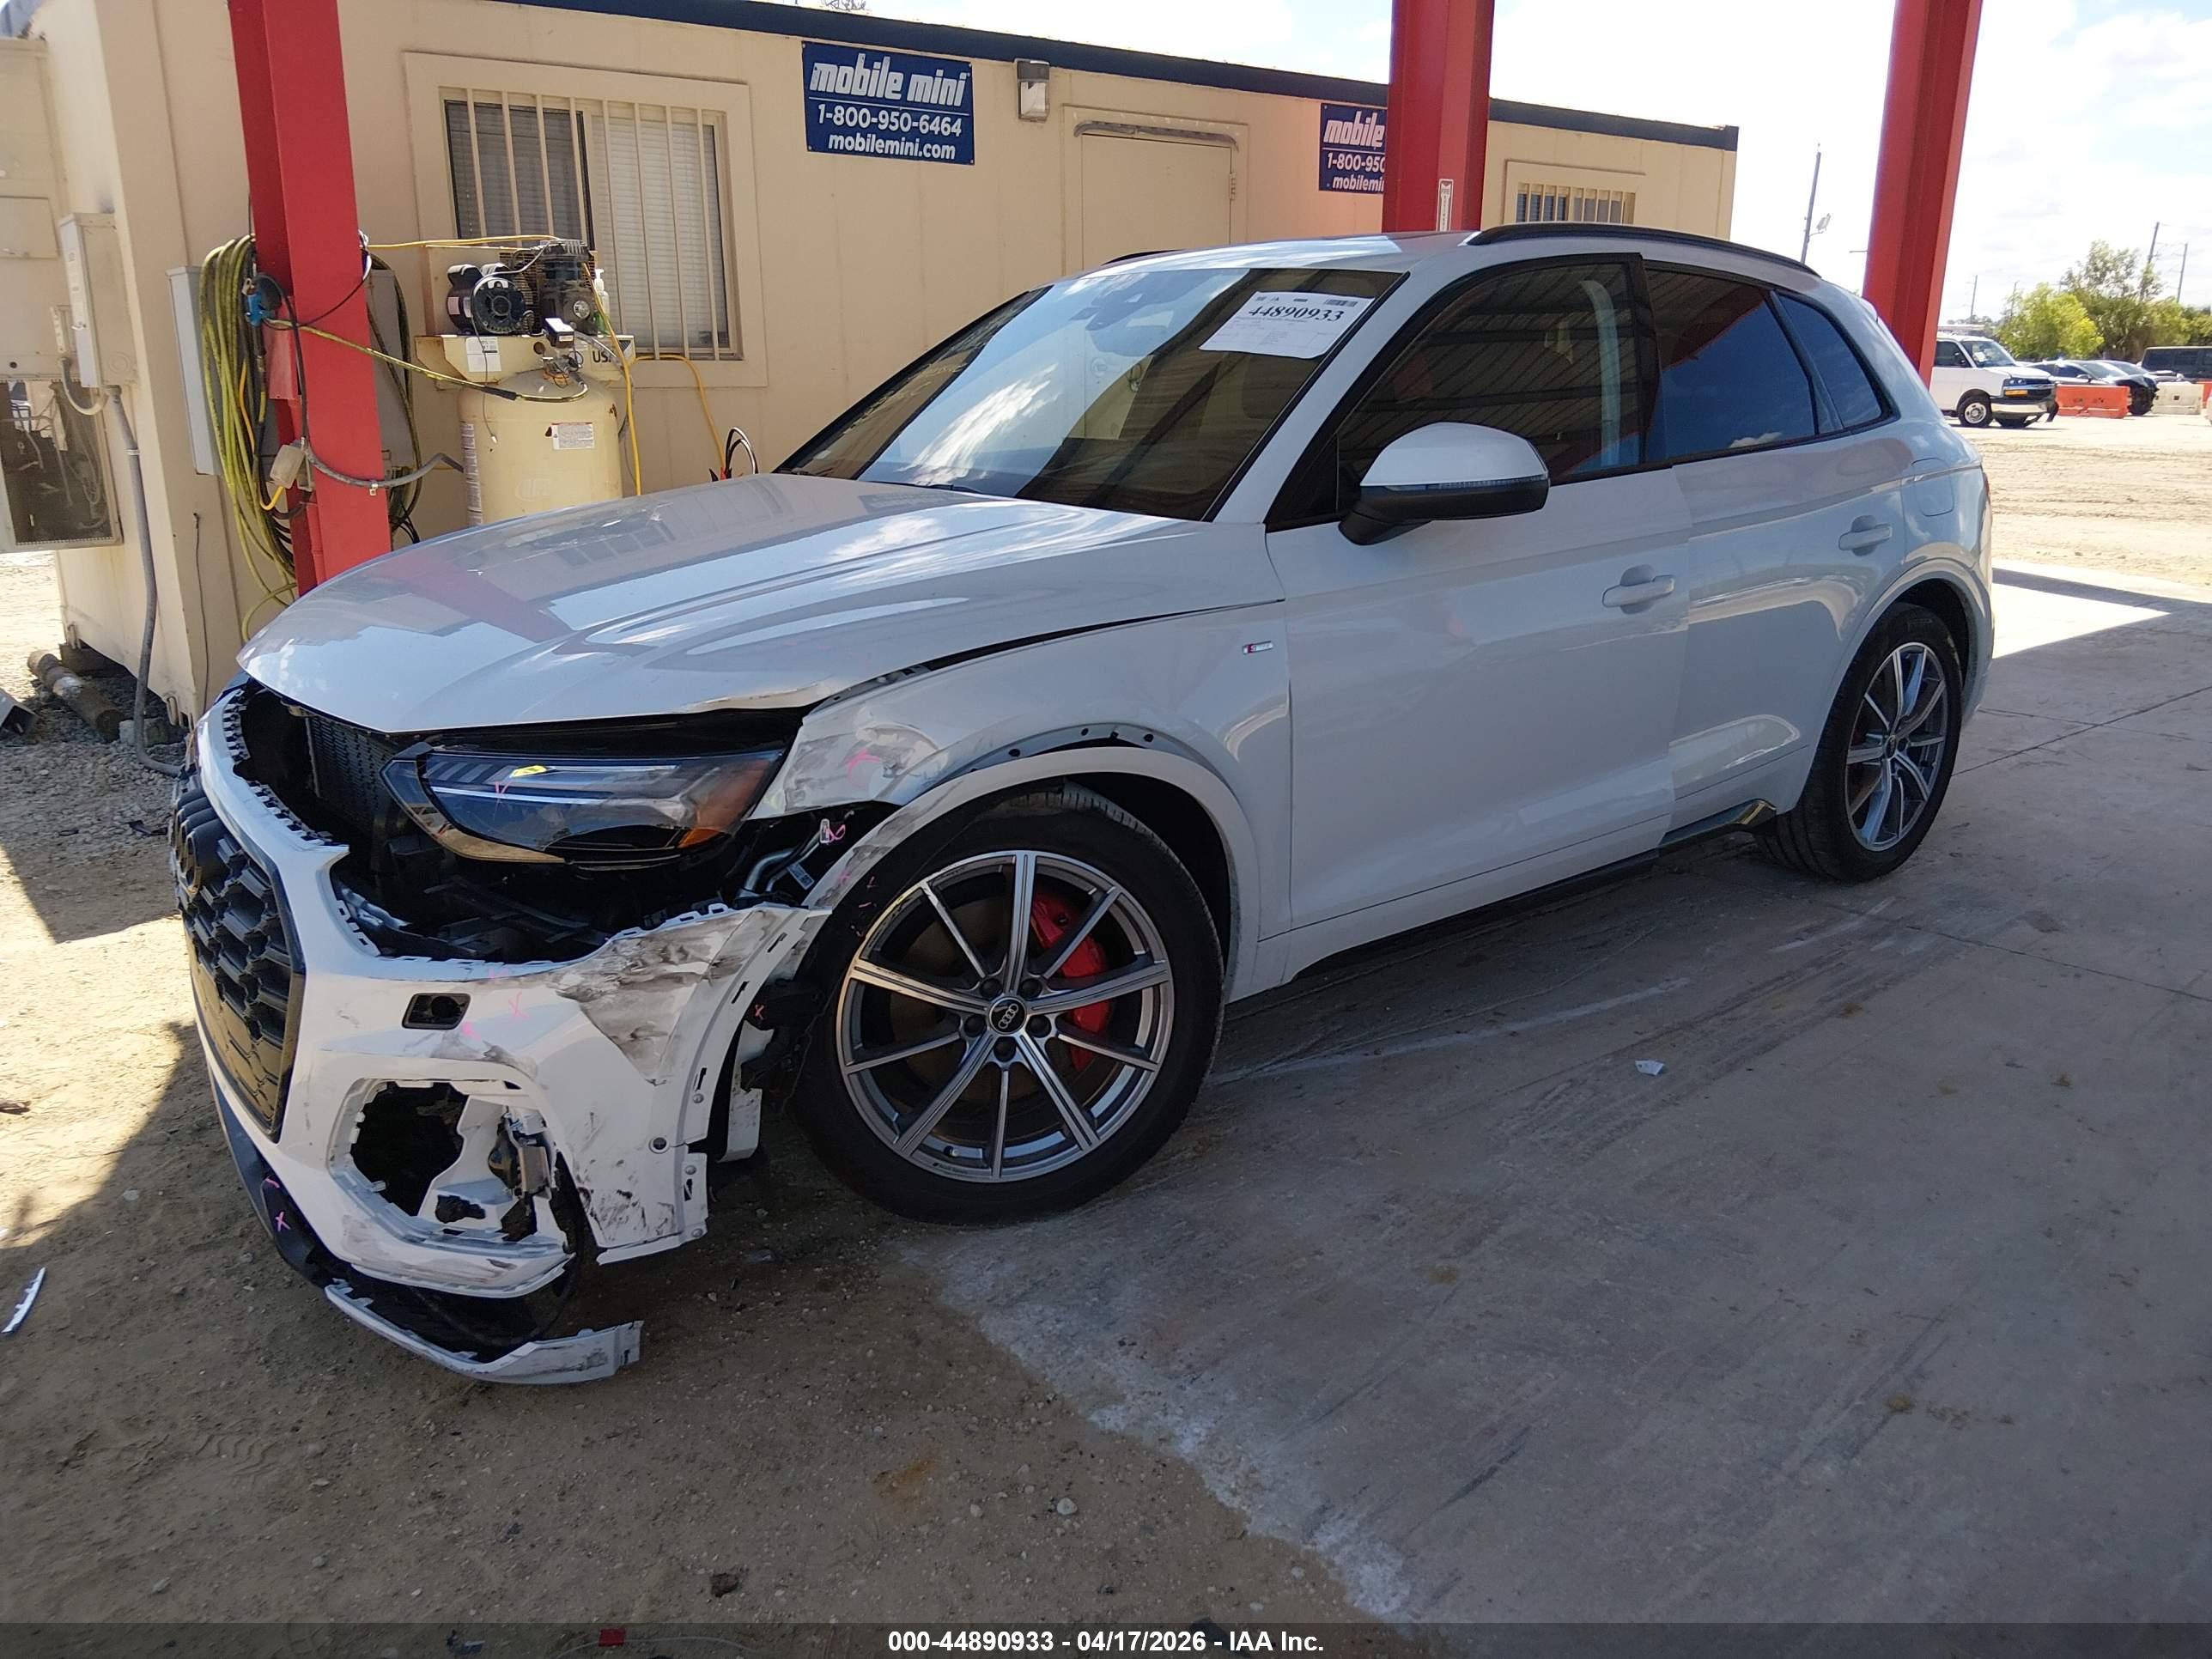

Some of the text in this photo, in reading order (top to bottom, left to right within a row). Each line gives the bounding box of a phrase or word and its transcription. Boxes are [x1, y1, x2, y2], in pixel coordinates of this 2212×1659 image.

[810, 52, 967, 106] mobile mini
[818, 104, 962, 137] 1-800-950-6464
[1323, 111, 1385, 148] mobile
[829, 132, 955, 160] mobilemini.com
[1249, 305, 1345, 322] 44890933
[592, 350, 611, 362] US
